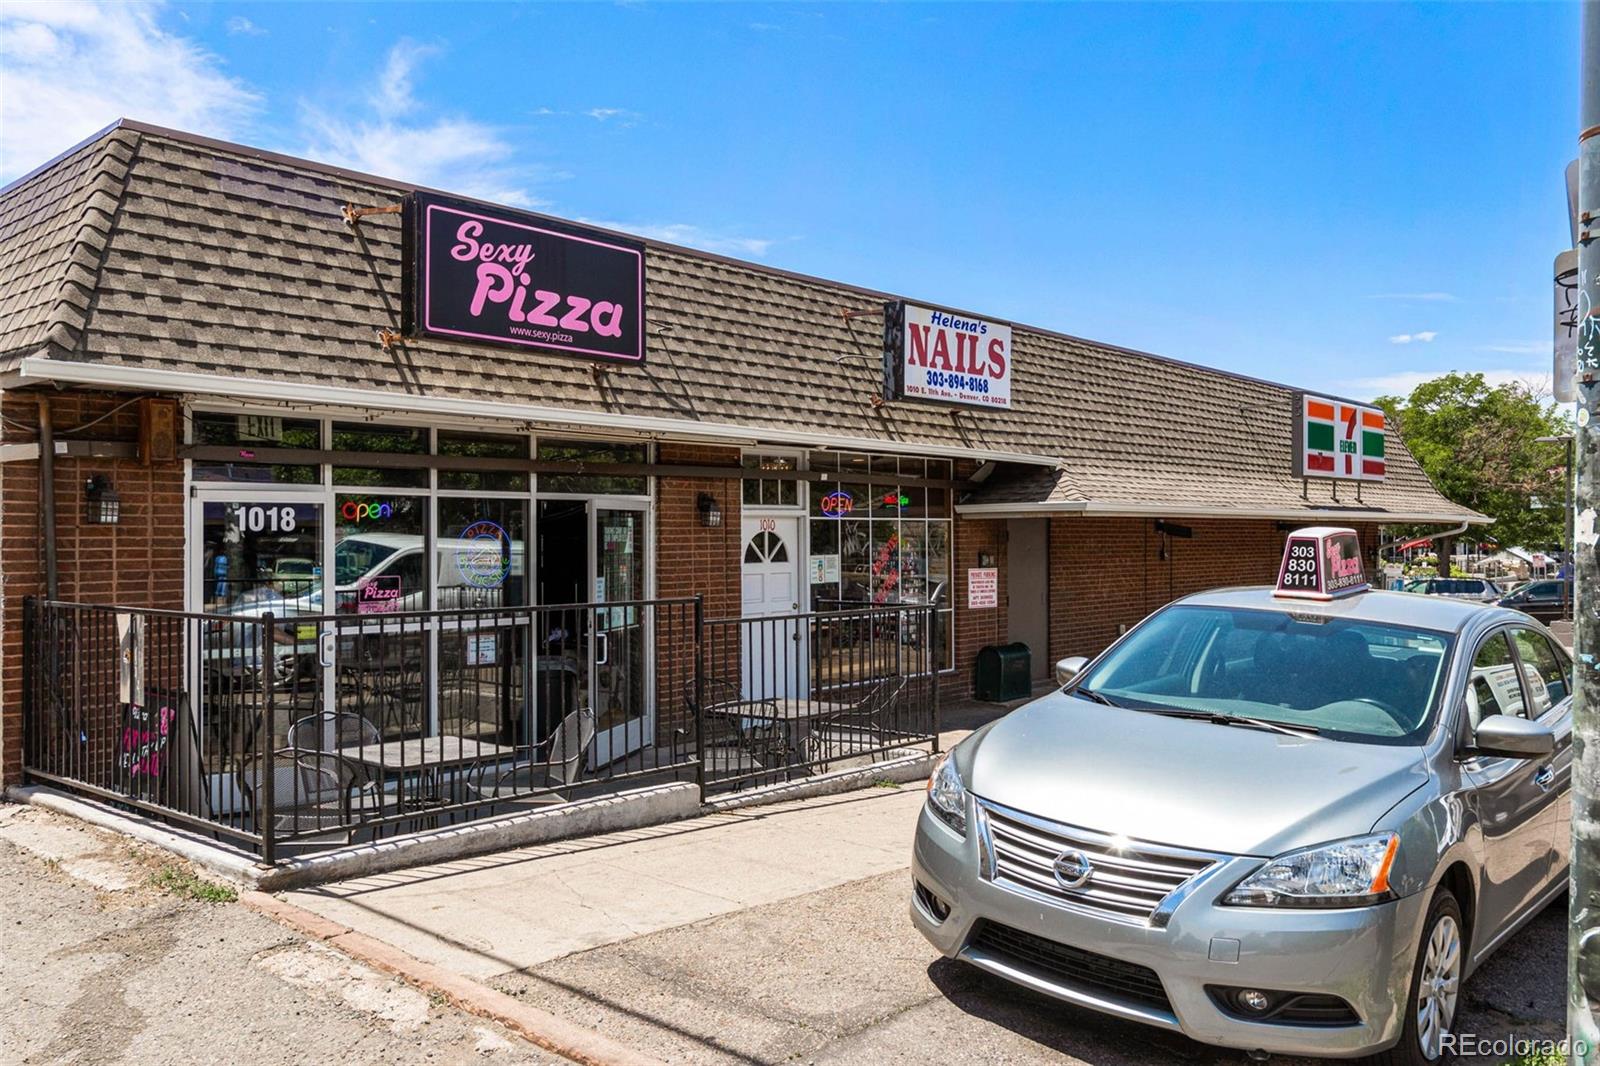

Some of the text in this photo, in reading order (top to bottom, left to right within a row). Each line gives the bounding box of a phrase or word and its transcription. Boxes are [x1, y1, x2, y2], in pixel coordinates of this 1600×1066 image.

[450, 220, 536, 276] Sexy
[470, 262, 623, 338] Pizza
[931, 311, 988, 334] Helena's
[509, 325, 573, 343] www.sexy.pizza
[908, 322, 1006, 379] NAILS
[906, 385, 919, 393] 1010
[341, 501, 391, 523] Open
[821, 496, 853, 513] OPEN
[234, 506, 296, 532] 1018
[760, 519, 776, 531] 1010
[1291, 546, 1315, 558] 303
[1288, 559, 1316, 572] 830
[1283, 572, 1317, 586] 8111
[364, 587, 399, 599] Pizza
